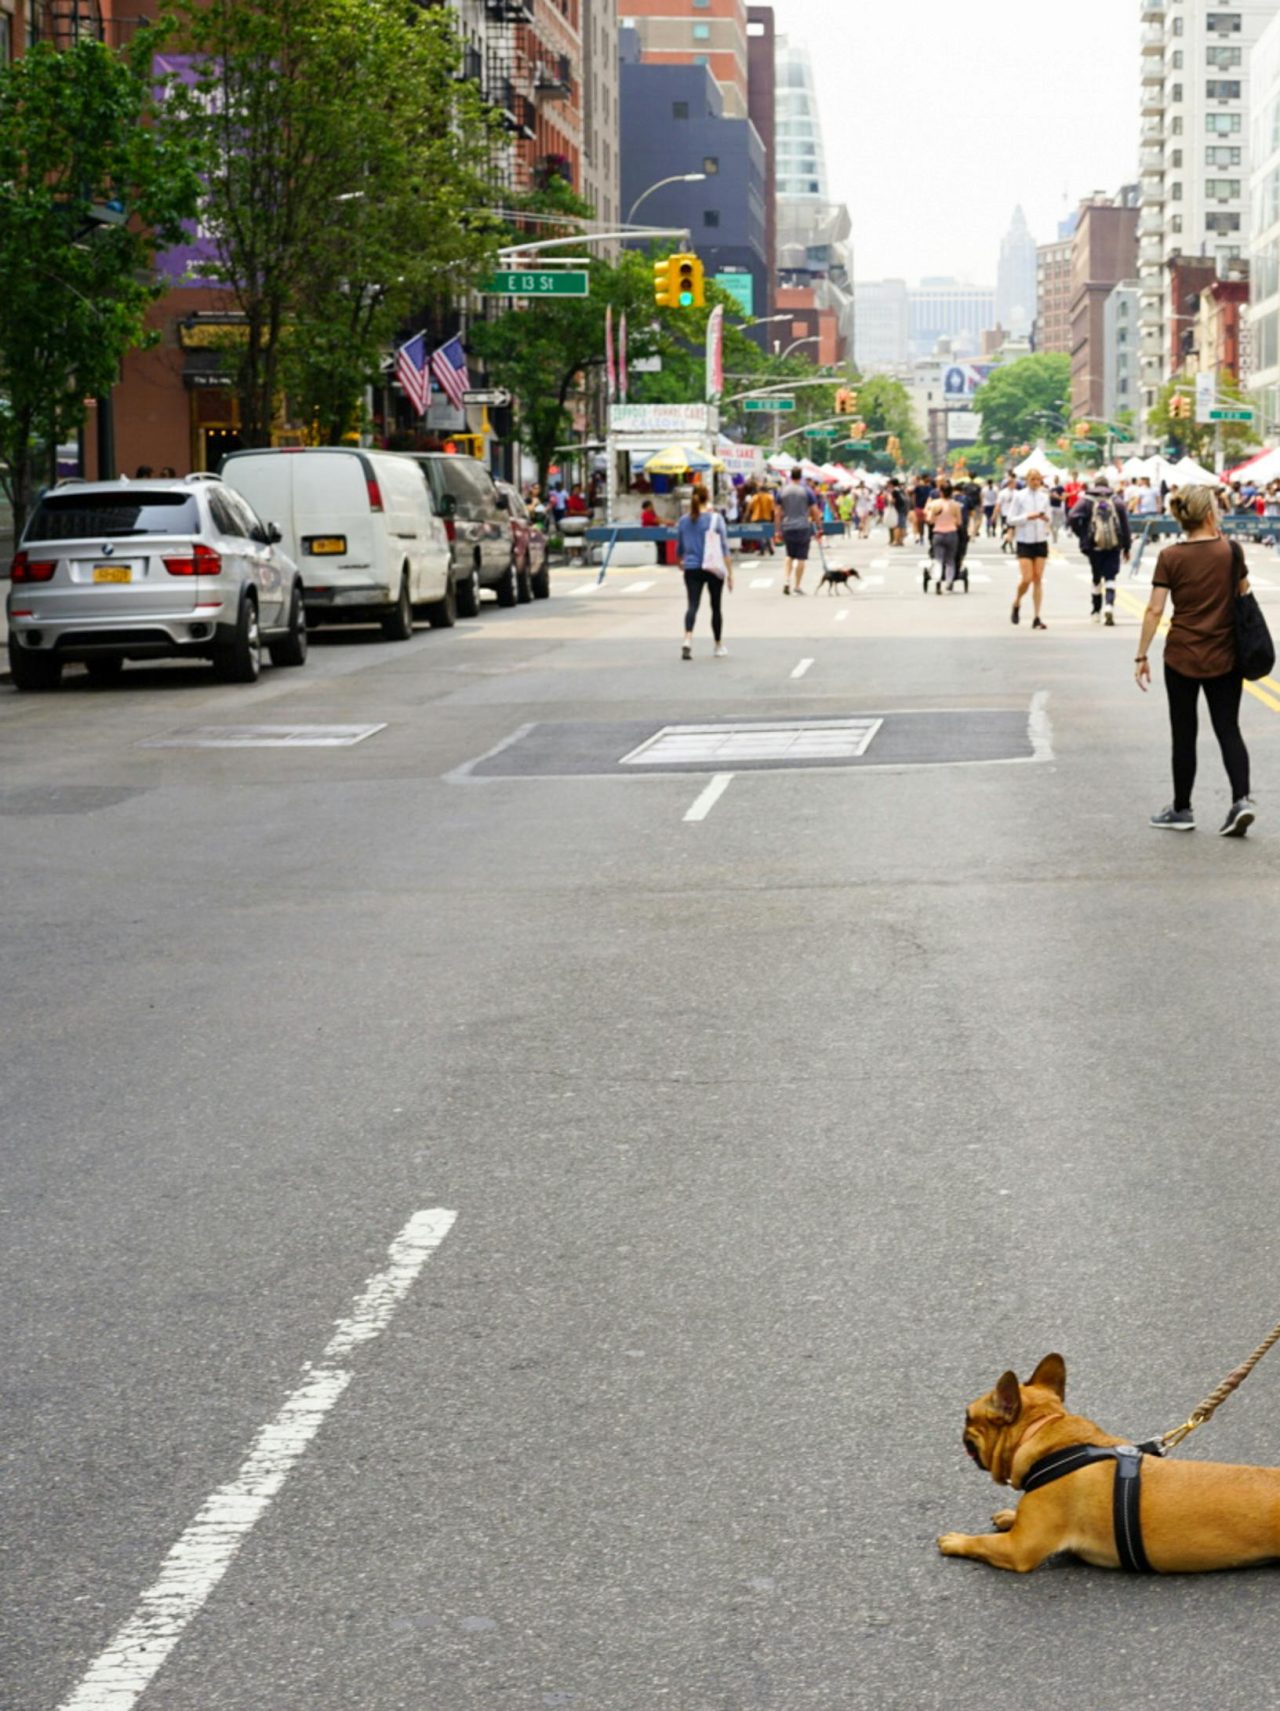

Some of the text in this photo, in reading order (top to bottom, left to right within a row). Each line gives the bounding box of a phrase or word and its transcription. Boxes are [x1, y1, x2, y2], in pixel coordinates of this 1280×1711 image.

[508, 276, 553, 290] E 13 St
